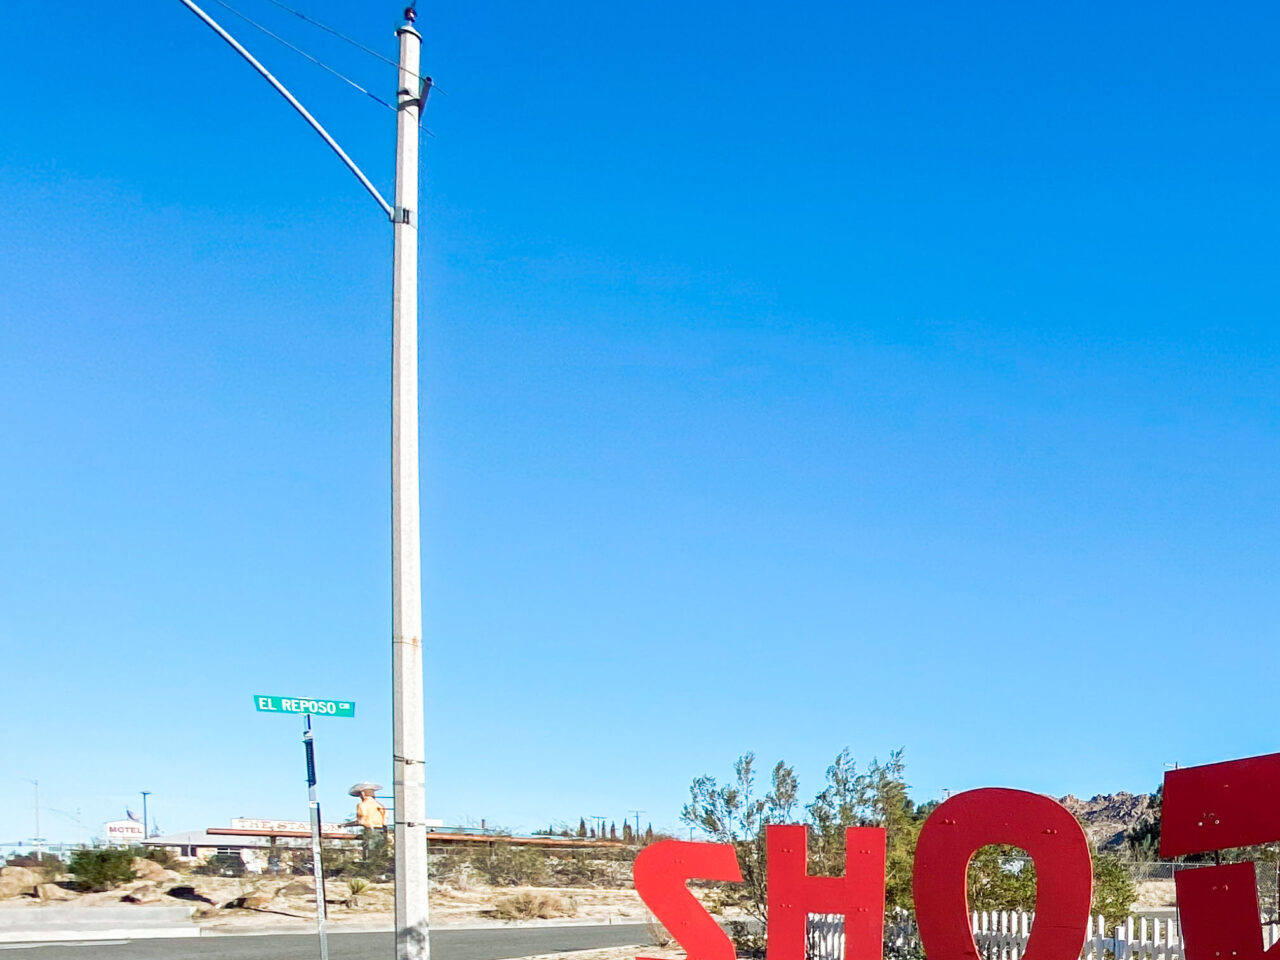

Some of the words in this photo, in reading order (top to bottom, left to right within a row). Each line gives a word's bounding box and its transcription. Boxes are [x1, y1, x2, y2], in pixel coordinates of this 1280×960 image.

[259, 697, 277, 710] EL
[281, 699, 336, 714] REPOSO
[108, 826, 143, 834] MOTEL
[238, 818, 273, 830] THE
[276, 820, 341, 832] STAON
